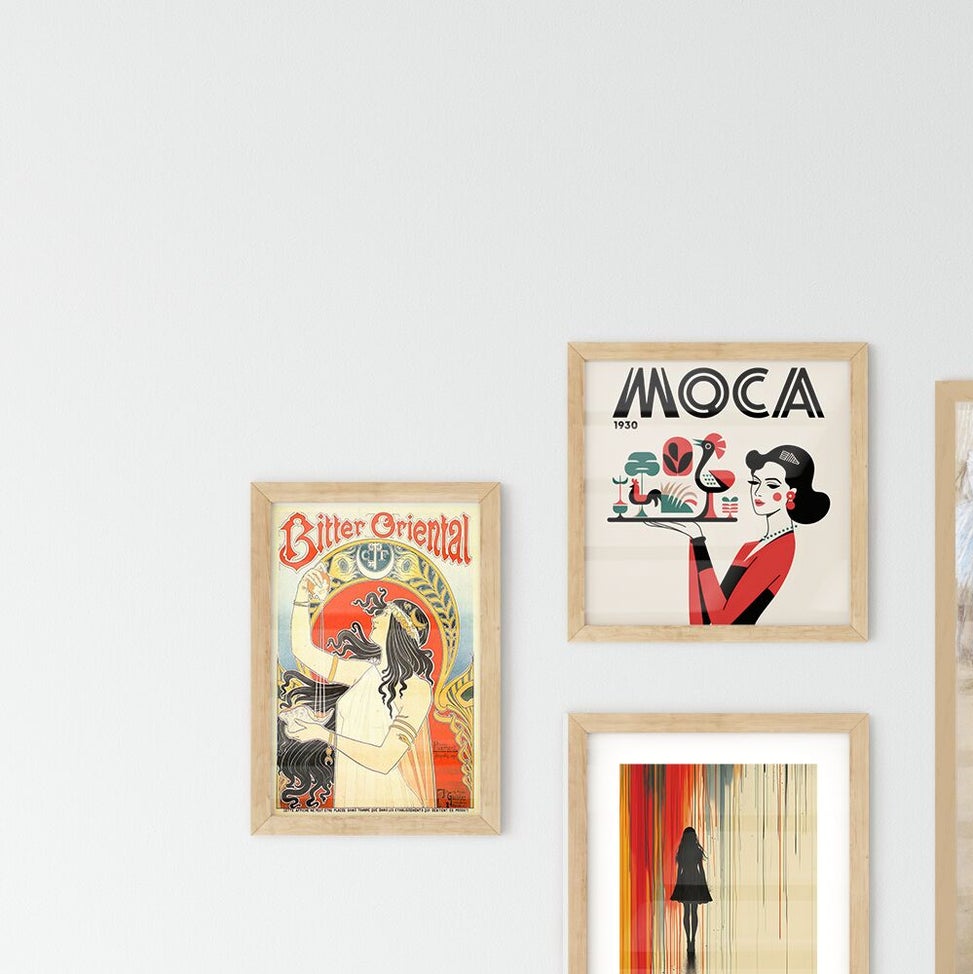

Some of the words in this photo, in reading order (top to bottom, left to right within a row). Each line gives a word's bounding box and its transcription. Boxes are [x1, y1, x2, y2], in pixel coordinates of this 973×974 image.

[612, 367, 825, 419] MOCA
[613, 421, 638, 430] 1930
[279, 512, 365, 571] Bitter
[371, 511, 472, 565] Oriental
